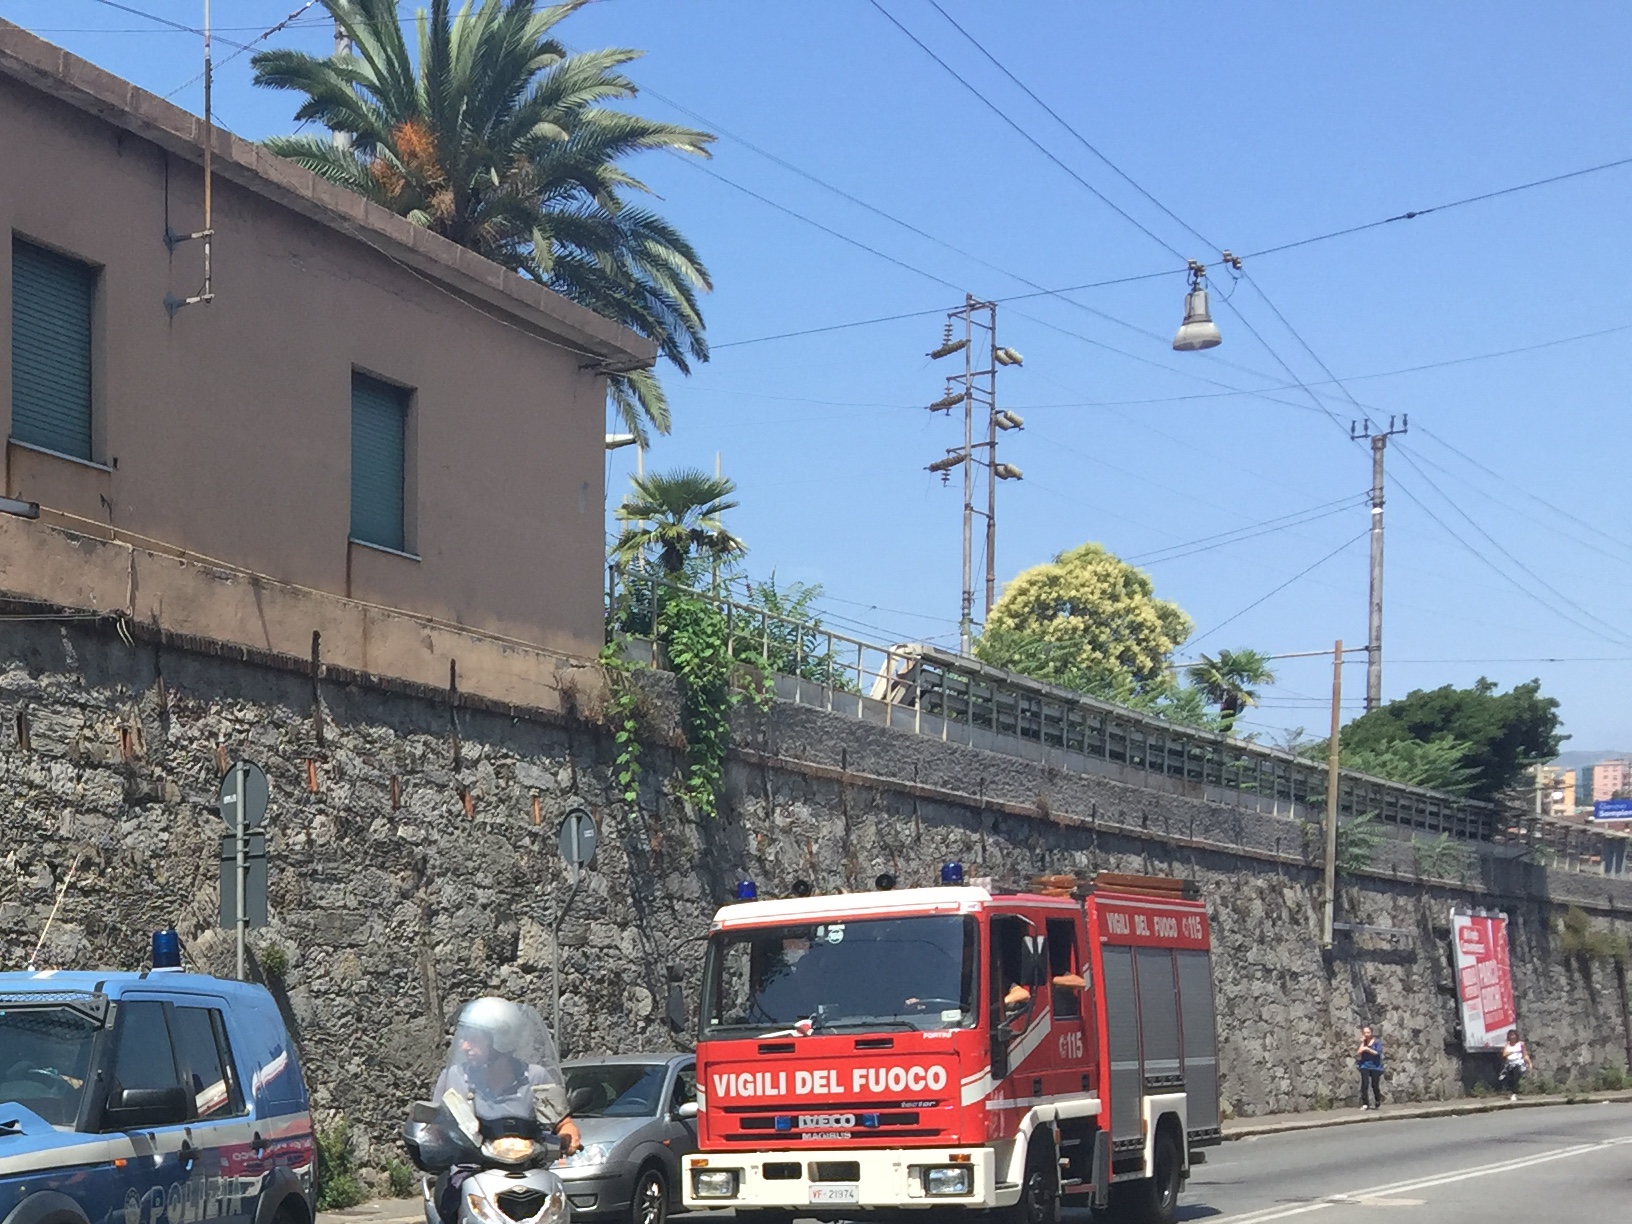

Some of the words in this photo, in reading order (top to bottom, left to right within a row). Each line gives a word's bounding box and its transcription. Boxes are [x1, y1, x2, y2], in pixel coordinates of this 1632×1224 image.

[1106, 912, 1131, 935] VIGILI
[1134, 914, 1151, 936] DEL
[1153, 916, 1179, 939] FUOCO
[1066, 1031, 1084, 1059] 115
[713, 1071, 787, 1098] VIGILI
[795, 1069, 845, 1095] DEL
[852, 1065, 947, 1093] FUOCO
[798, 1113, 856, 1129] IVECO
